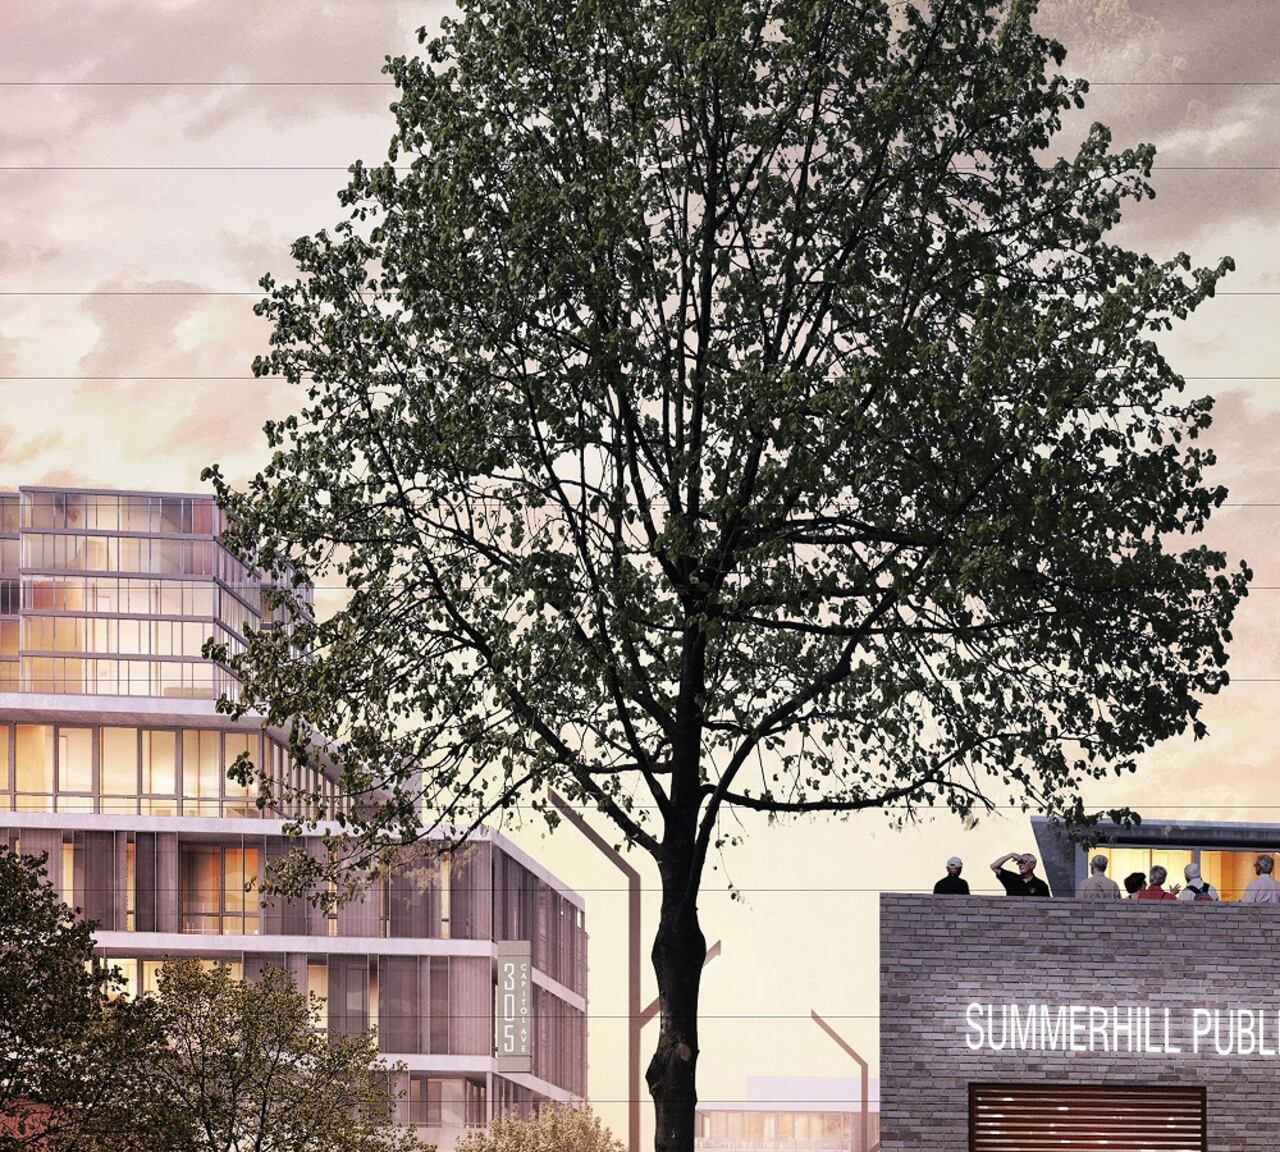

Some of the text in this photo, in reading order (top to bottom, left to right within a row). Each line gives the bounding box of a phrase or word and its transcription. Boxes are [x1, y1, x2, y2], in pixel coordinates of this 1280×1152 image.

[504, 963, 515, 1052] 305
[965, 1002, 1182, 1054] SUMMERHILL
[520, 1029, 528, 1053] AVE
